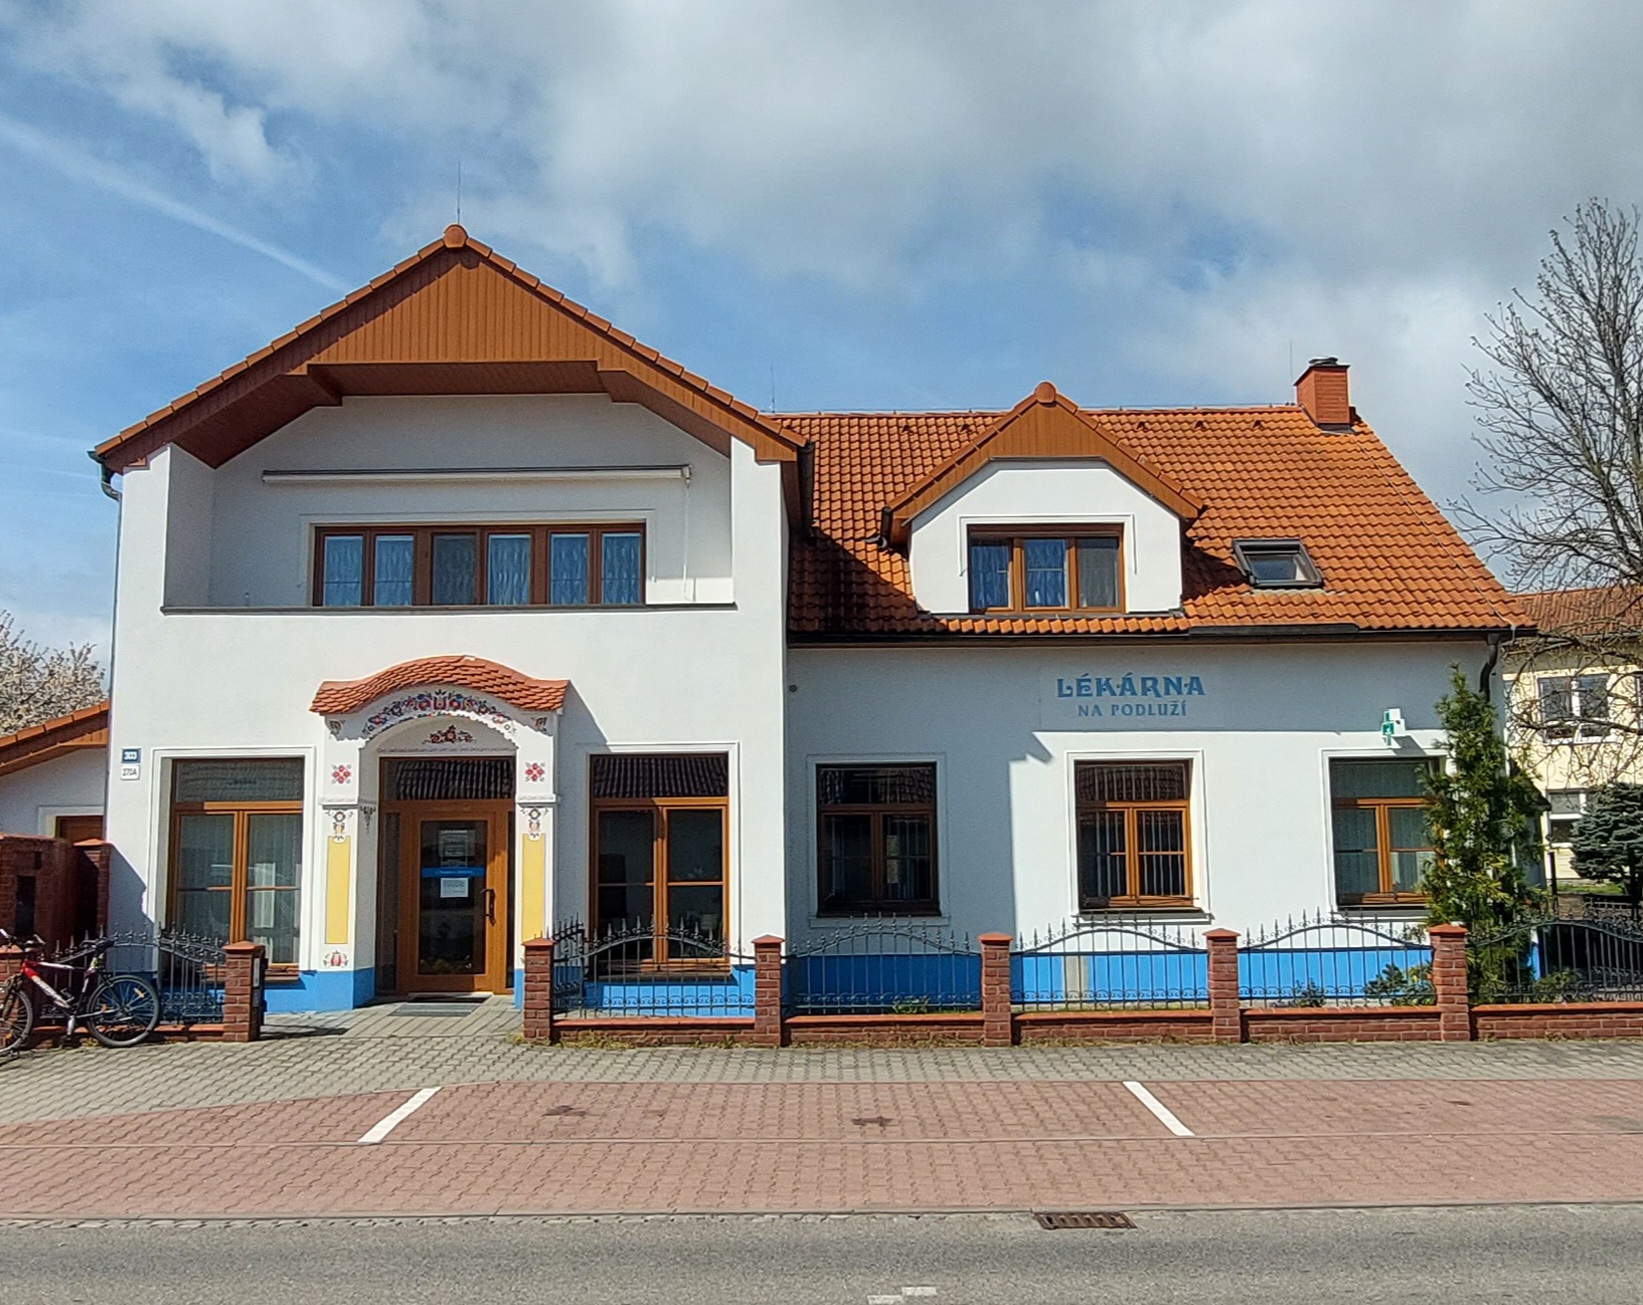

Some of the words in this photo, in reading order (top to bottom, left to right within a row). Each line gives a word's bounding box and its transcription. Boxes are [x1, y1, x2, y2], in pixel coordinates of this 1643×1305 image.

[1057, 672, 1205, 697] LÉKÁRNA
[1078, 704, 1102, 717] NA
[1111, 700, 1187, 716] PODLUŽÍ
